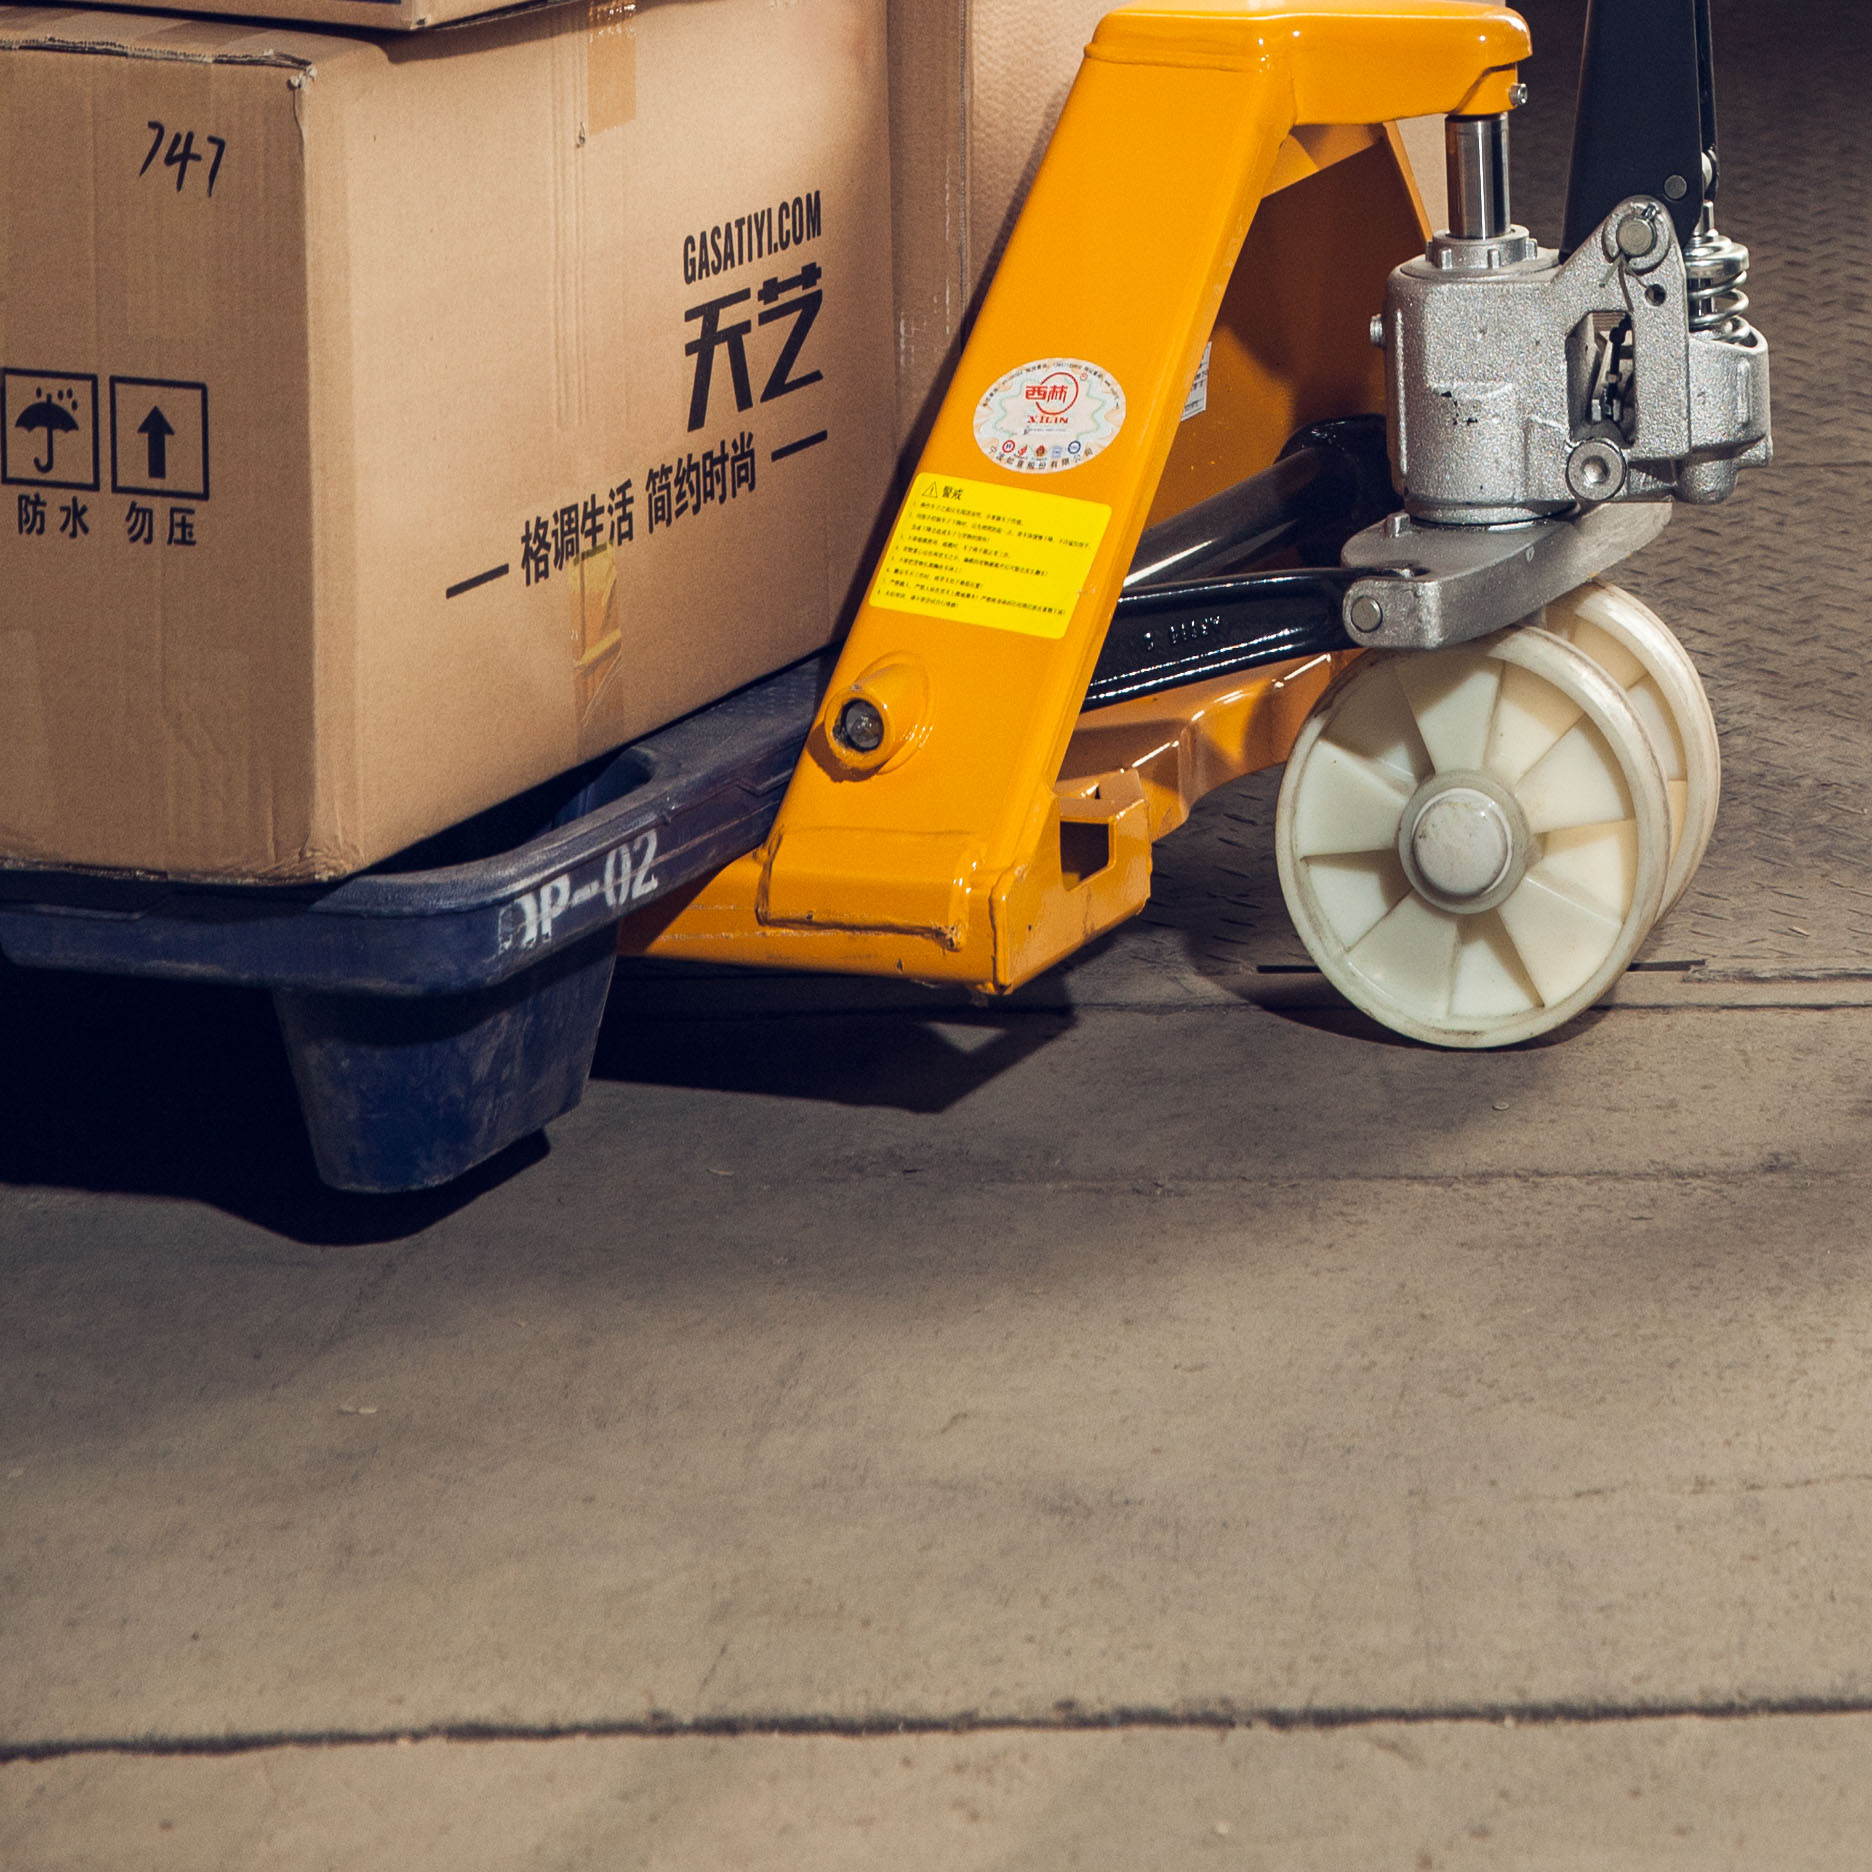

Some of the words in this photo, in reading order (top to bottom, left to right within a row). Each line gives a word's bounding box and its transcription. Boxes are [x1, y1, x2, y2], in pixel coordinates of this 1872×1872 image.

[138, 120, 226, 198] 747
[683, 189, 823, 285] GASATIYI.COM
[684, 261, 824, 433] 天艺
[1025, 384, 1069, 404] 西林
[1027, 415, 1069, 425] XILIN
[17, 492, 90, 540] 防水
[124, 500, 198, 547] 勿压
[520, 477, 635, 587] 格调生活
[645, 430, 756, 535] 简约时尚
